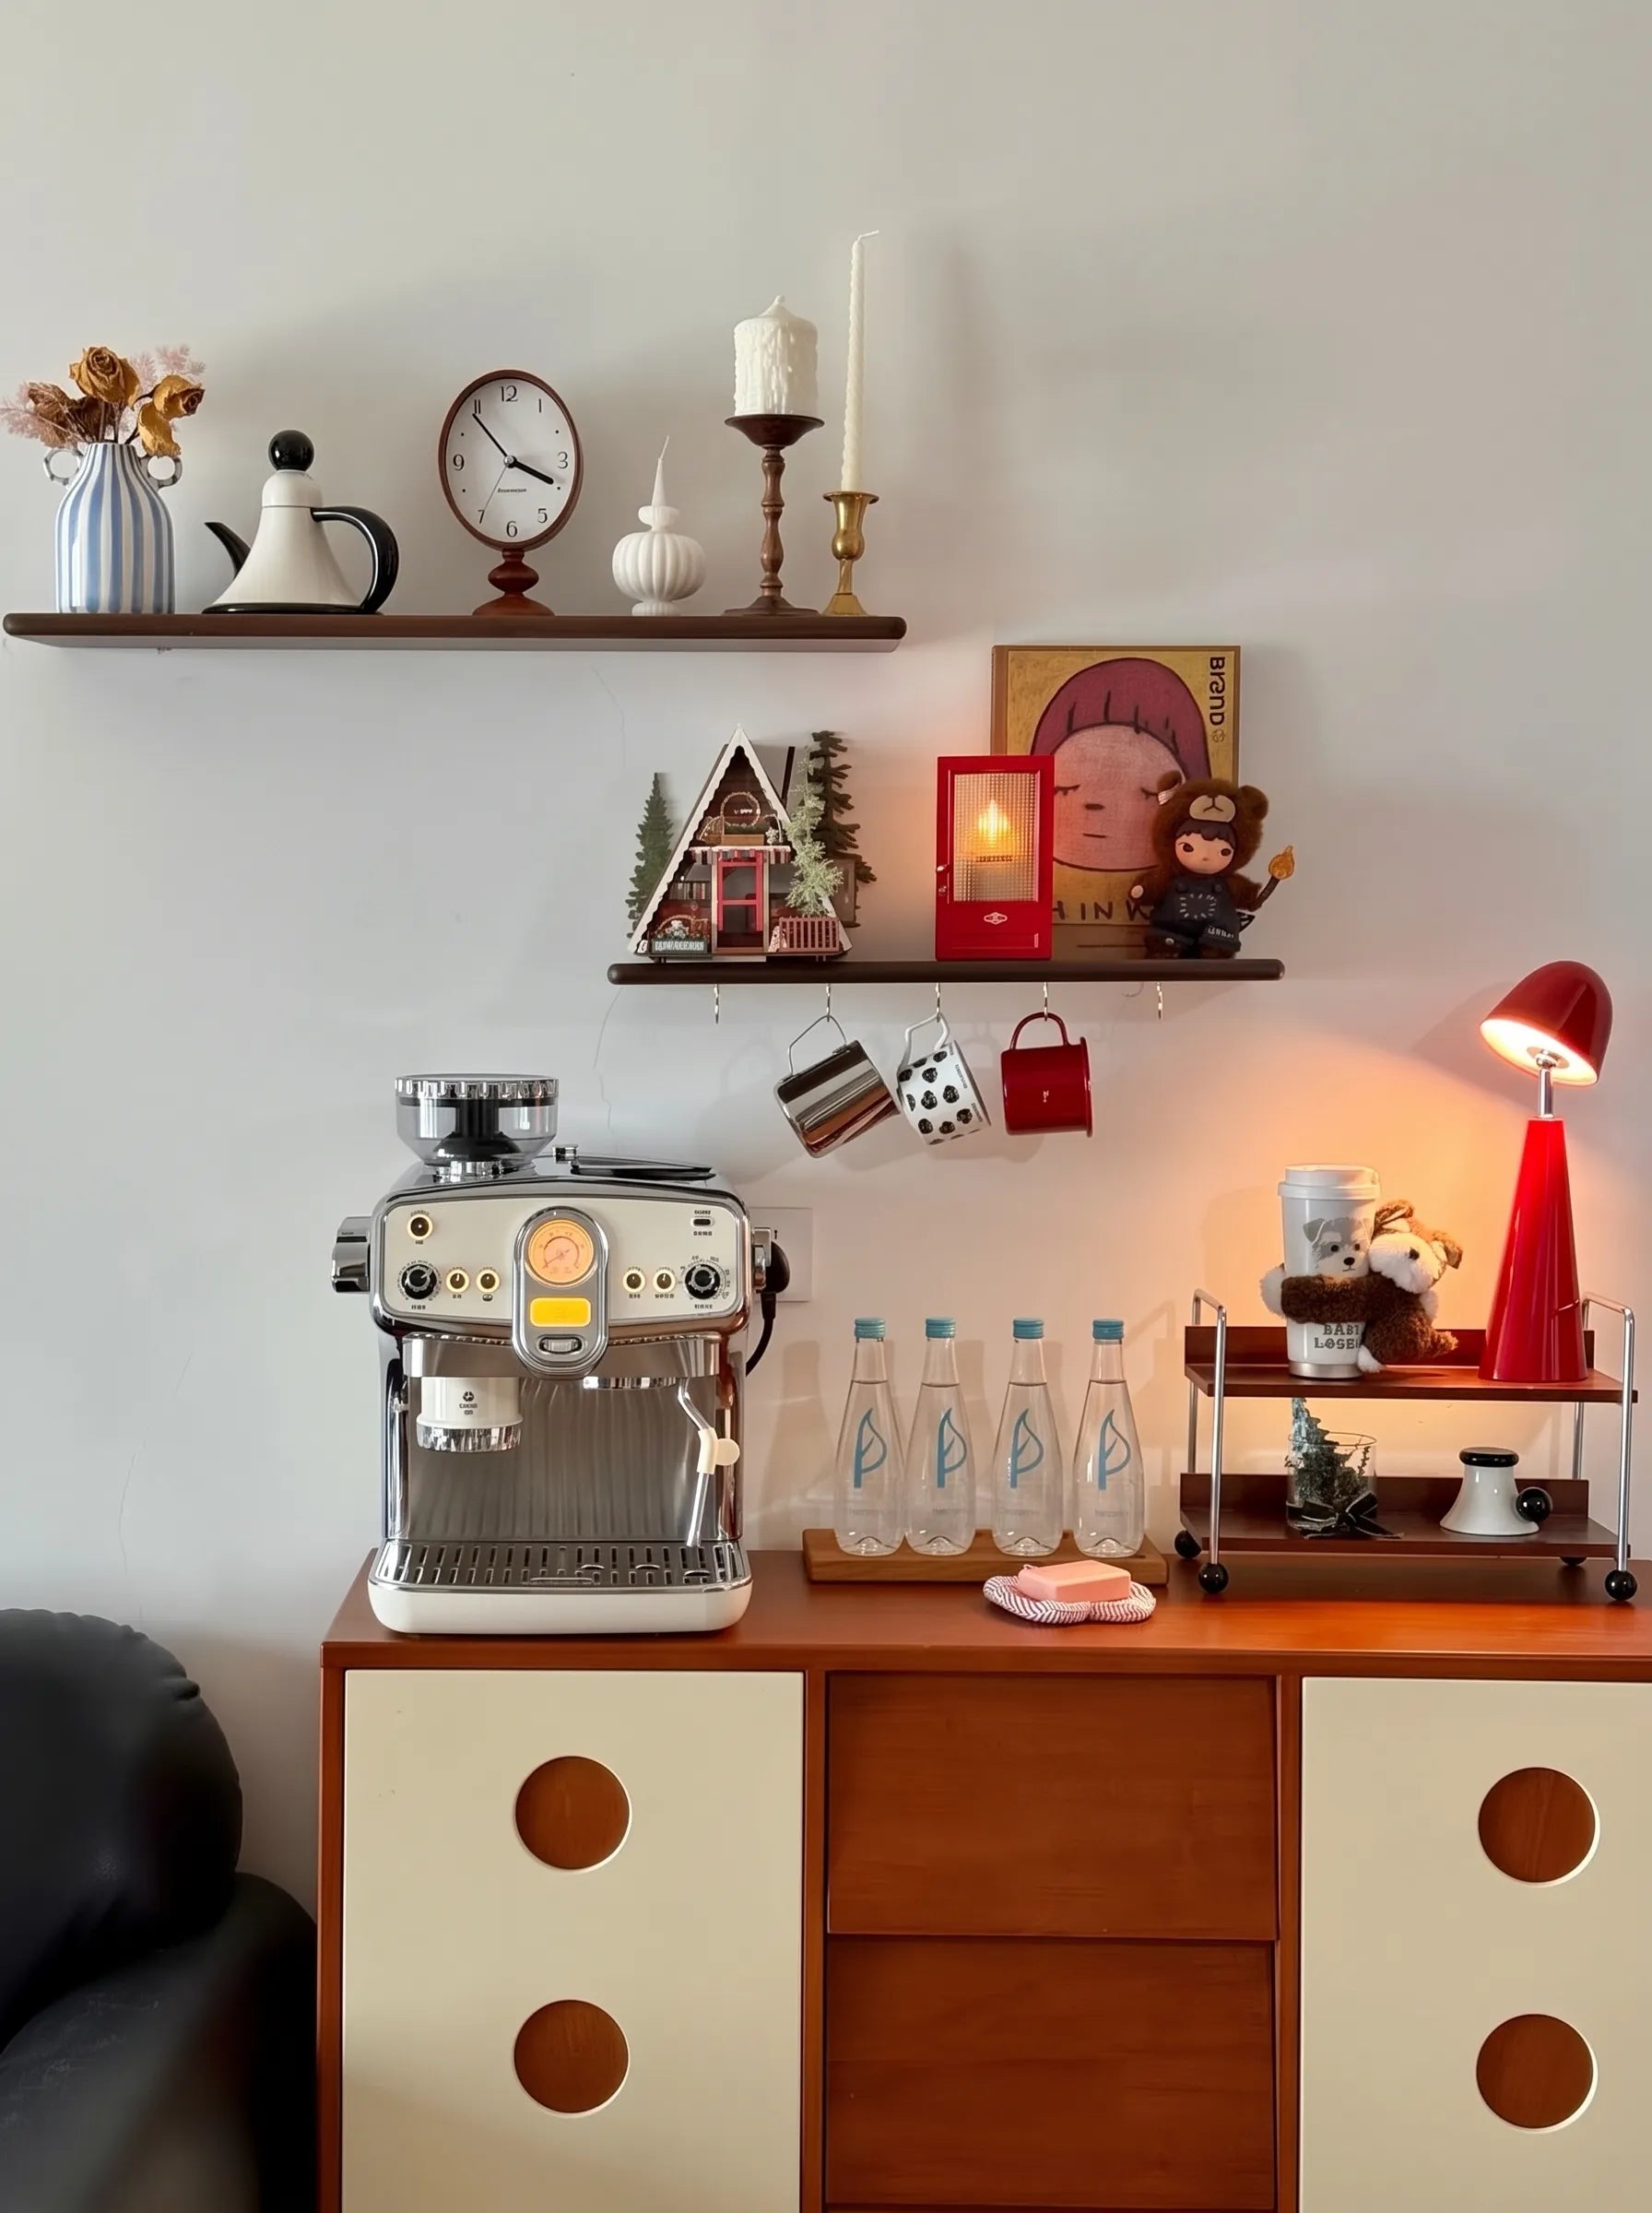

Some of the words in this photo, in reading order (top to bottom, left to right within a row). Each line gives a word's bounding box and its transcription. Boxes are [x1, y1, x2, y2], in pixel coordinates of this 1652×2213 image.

[501, 385, 518, 402] 12
[474, 399, 481, 414] 11
[453, 454, 465, 470] 9
[557, 451, 569, 468] 3
[478, 509, 485, 524] 7
[537, 508, 548, 523] 5
[506, 520, 518, 538] 6
[1314, 1337, 1359, 1349] LOSE
